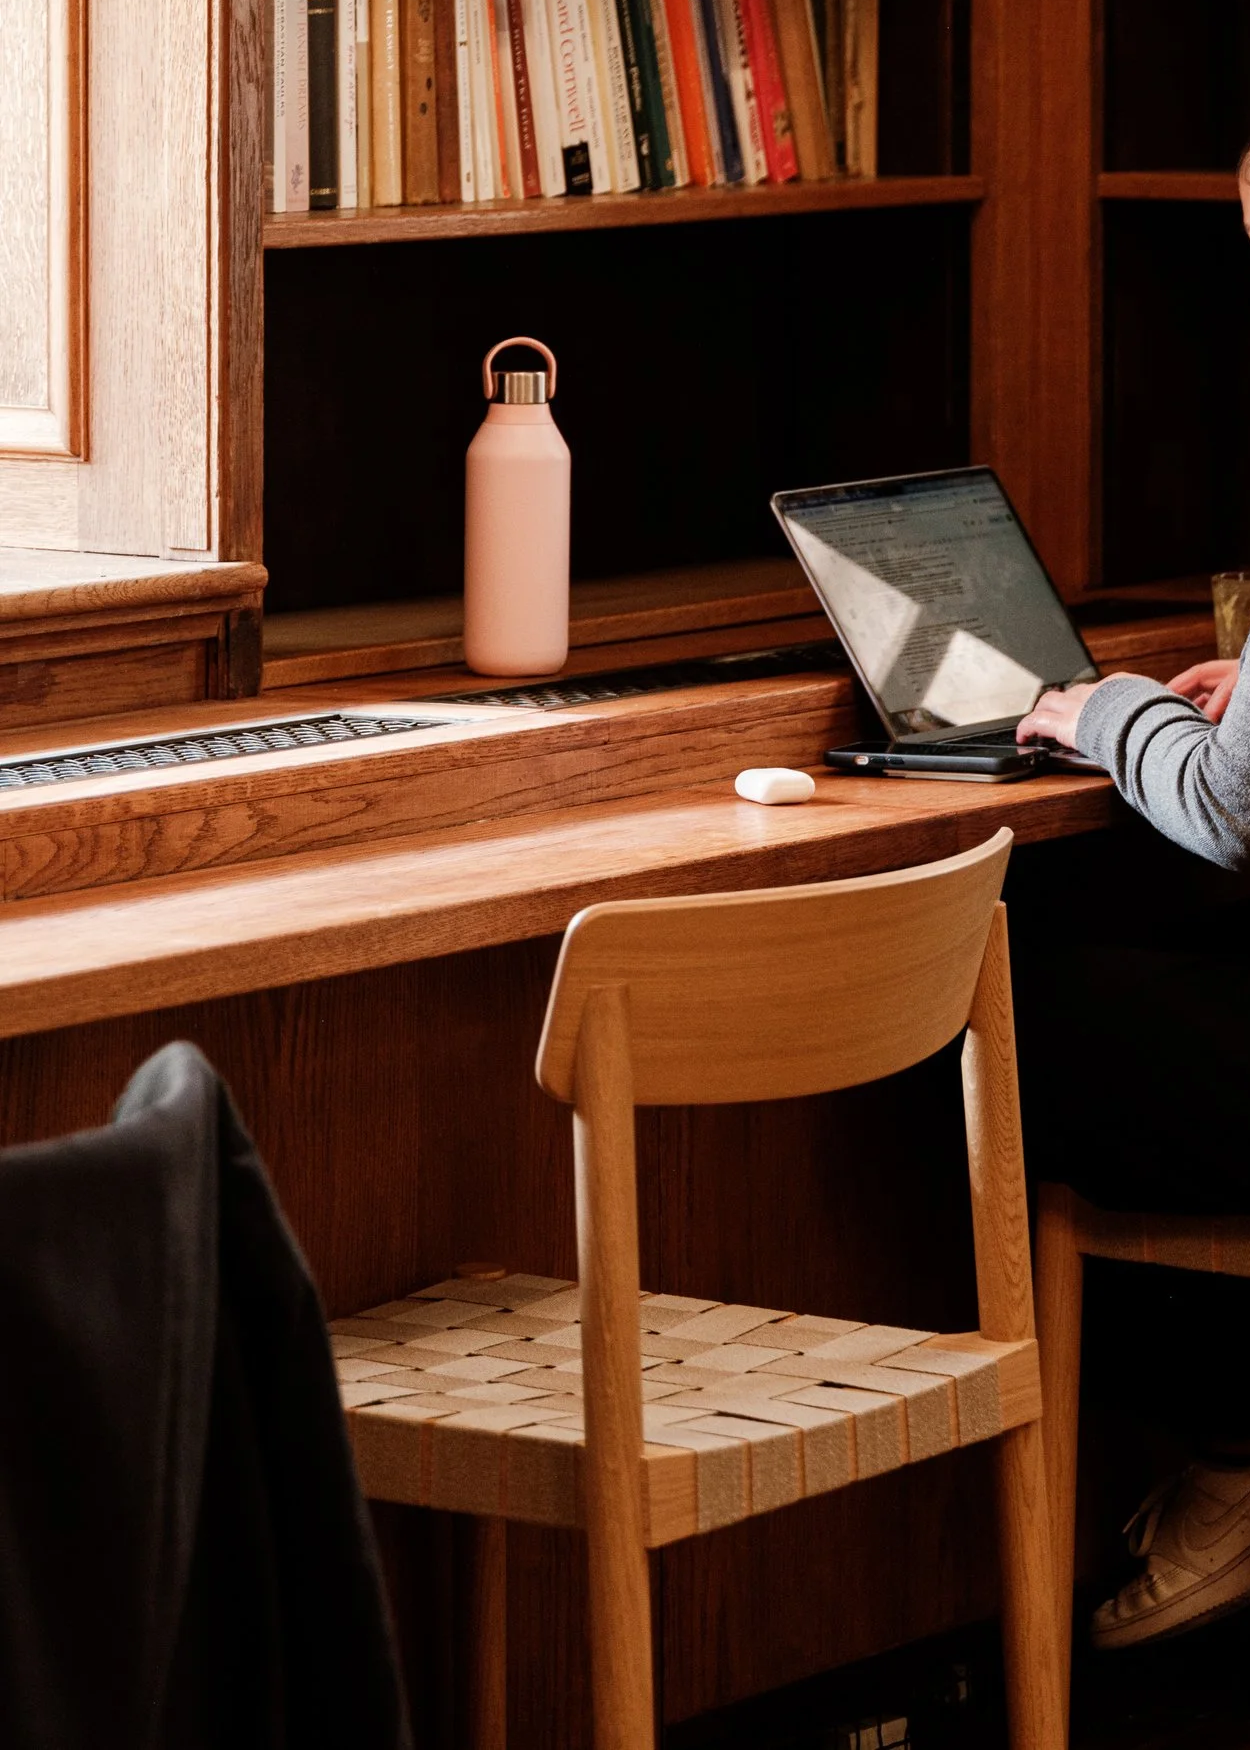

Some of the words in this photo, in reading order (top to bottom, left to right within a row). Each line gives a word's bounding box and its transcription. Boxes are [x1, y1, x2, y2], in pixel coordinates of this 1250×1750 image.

[296, 0, 308, 13] OF
[297, 22, 308, 73] DANISH
[385, 8, 394, 70] TREASURY
[512, 29, 524, 72] Hislop
[297, 80, 308, 131] DREAMS
[517, 77, 528, 104] The
[560, 39, 587, 134] Cornwell
[521, 108, 532, 149] Island
